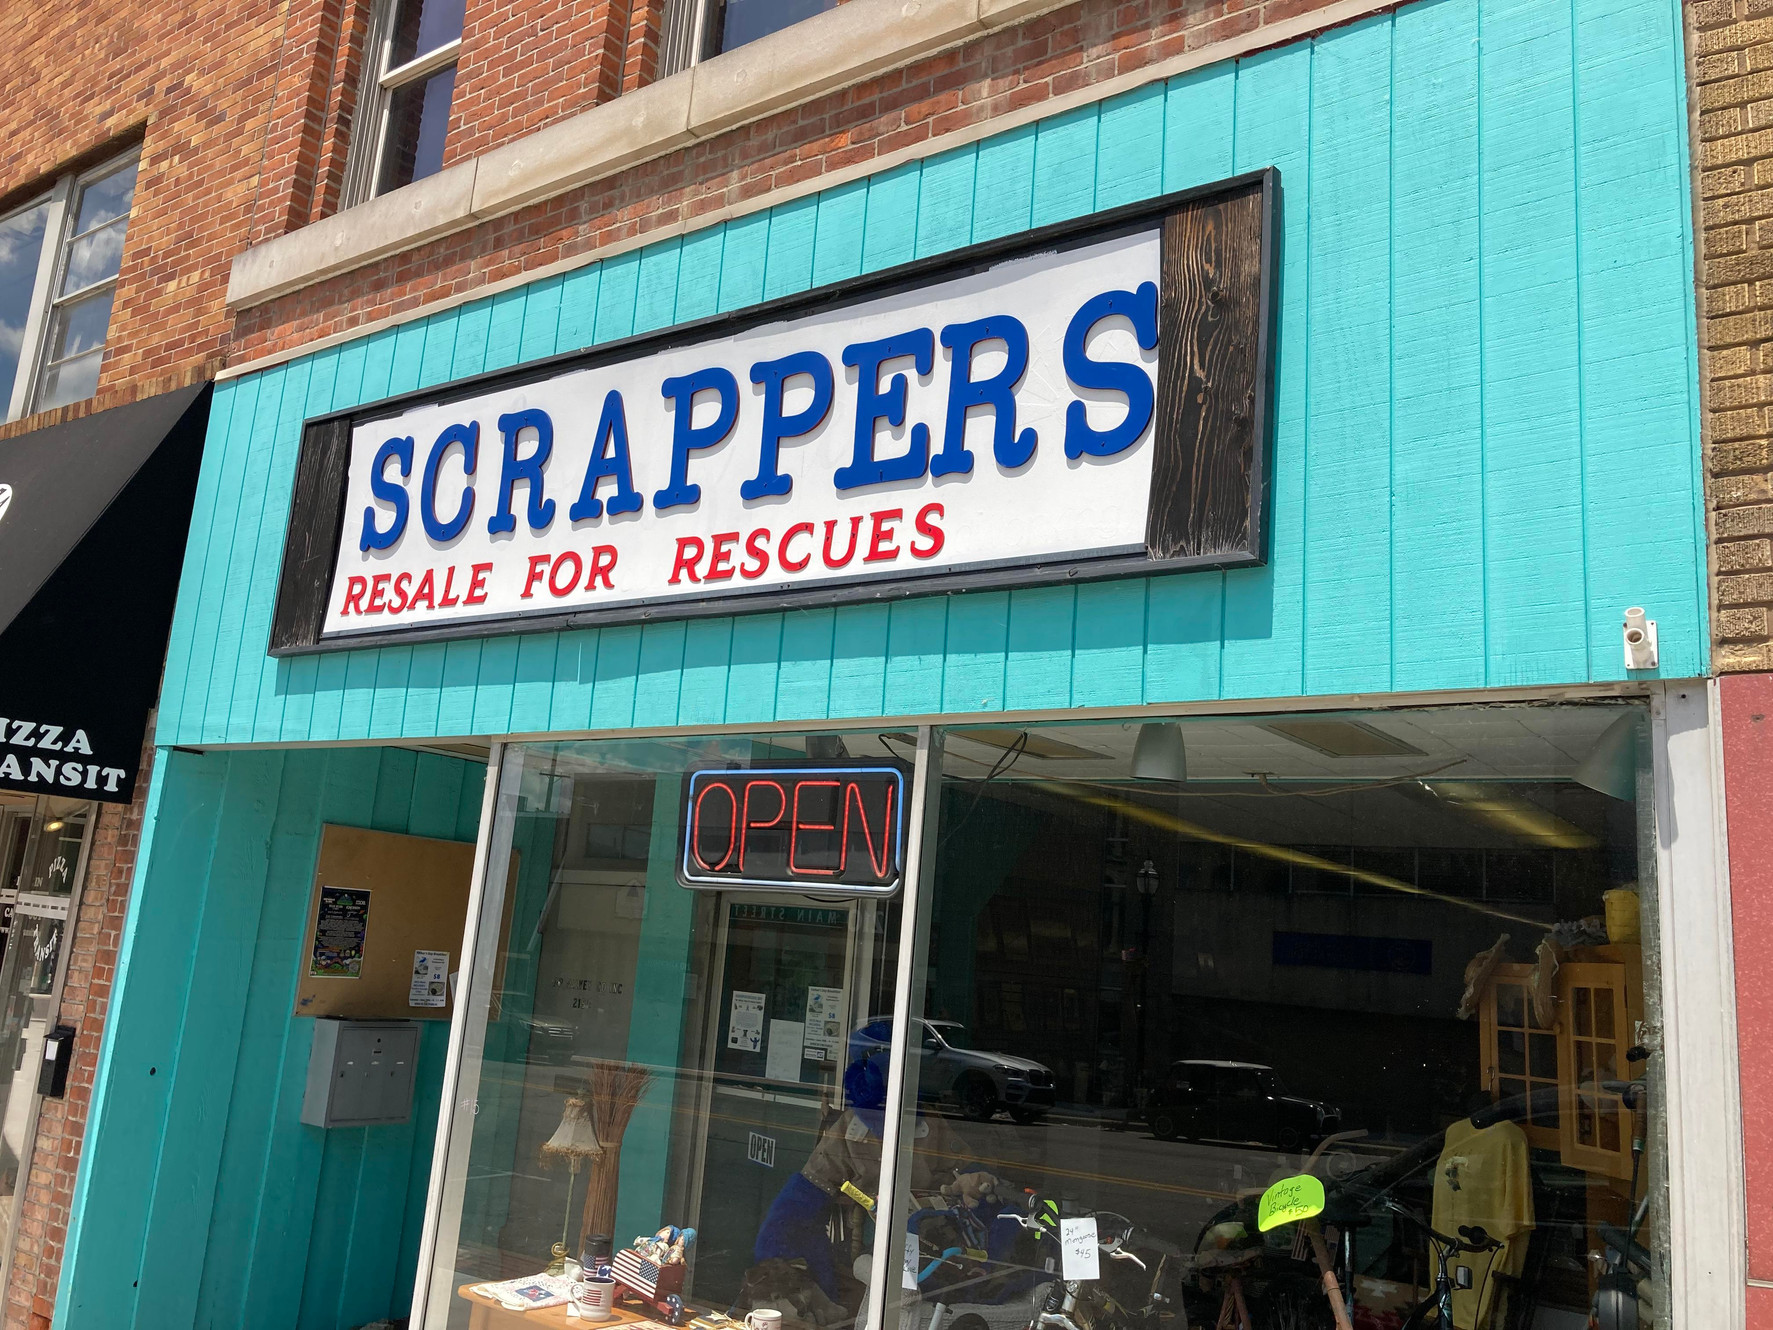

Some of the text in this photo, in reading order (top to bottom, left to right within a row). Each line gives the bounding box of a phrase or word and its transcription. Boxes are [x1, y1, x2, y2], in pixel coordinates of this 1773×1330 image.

[360, 281, 1160, 552] SCRAPPERS
[341, 502, 945, 616] RESALE FOR RESCUES
[692, 779, 894, 879] OPEN
[48, 855, 69, 884] PIZZA
[33, 923, 58, 962] TRANSIT
[750, 1133, 774, 1165] OPEN
[1266, 1183, 1302, 1207] Vintage
[1268, 1196, 1301, 1217] Bicycle
[1288, 1204, 1309, 1217] $50
